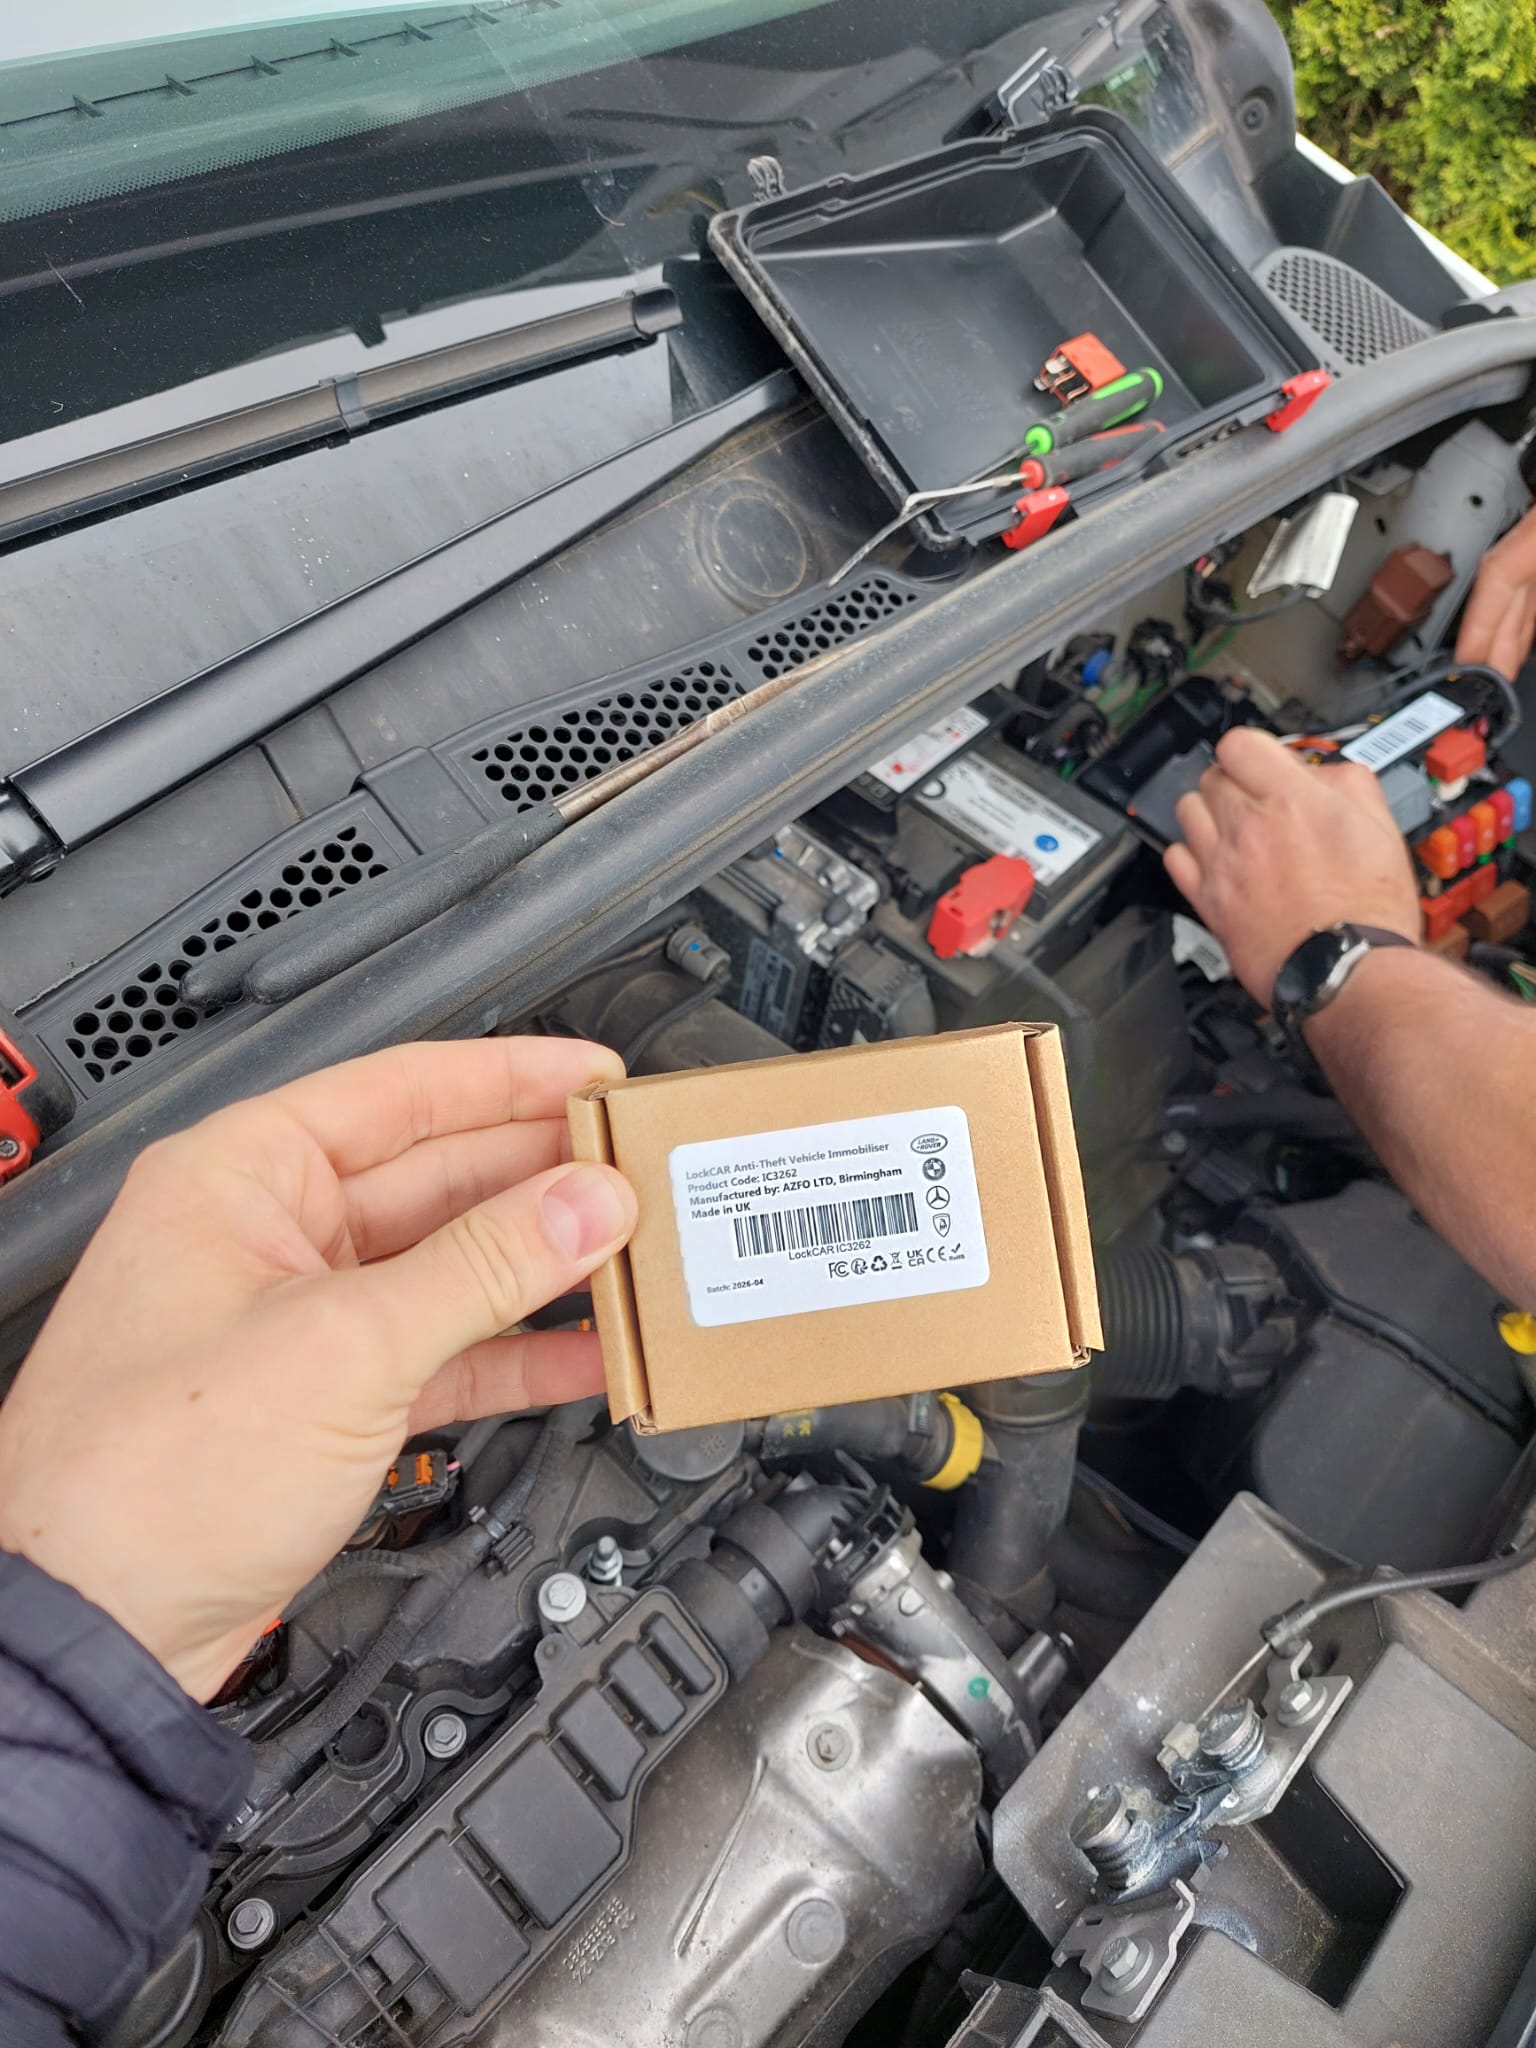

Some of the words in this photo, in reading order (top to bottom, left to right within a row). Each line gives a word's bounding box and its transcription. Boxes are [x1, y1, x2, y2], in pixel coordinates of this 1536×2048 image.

[686, 1165, 731, 1180] LockCAR
[734, 1156, 787, 1173] Anti-Theft
[789, 1151, 826, 1165] Vehicle
[828, 1143, 890, 1159] Immobiliser
[688, 1180, 729, 1193] Product
[730, 1175, 760, 1187] Code:
[762, 1168, 798, 1182] IC3262
[690, 1186, 761, 1206] Manufactured
[764, 1185, 780, 1197] by:
[783, 1180, 811, 1192] AZFO
[813, 1176, 837, 1187] LTD,
[839, 1168, 902, 1184] Birmingham
[691, 1207, 720, 1219] Made
[723, 1205, 733, 1215] in
[735, 1201, 751, 1213] UK
[789, 1245, 834, 1261] LockCAR
[837, 1239, 871, 1255] IC3262
[906, 1249, 924, 1258] UK
[926, 1245, 947, 1263] CE
[908, 1257, 925, 1267] CA
[707, 1284, 731, 1294] Batch:
